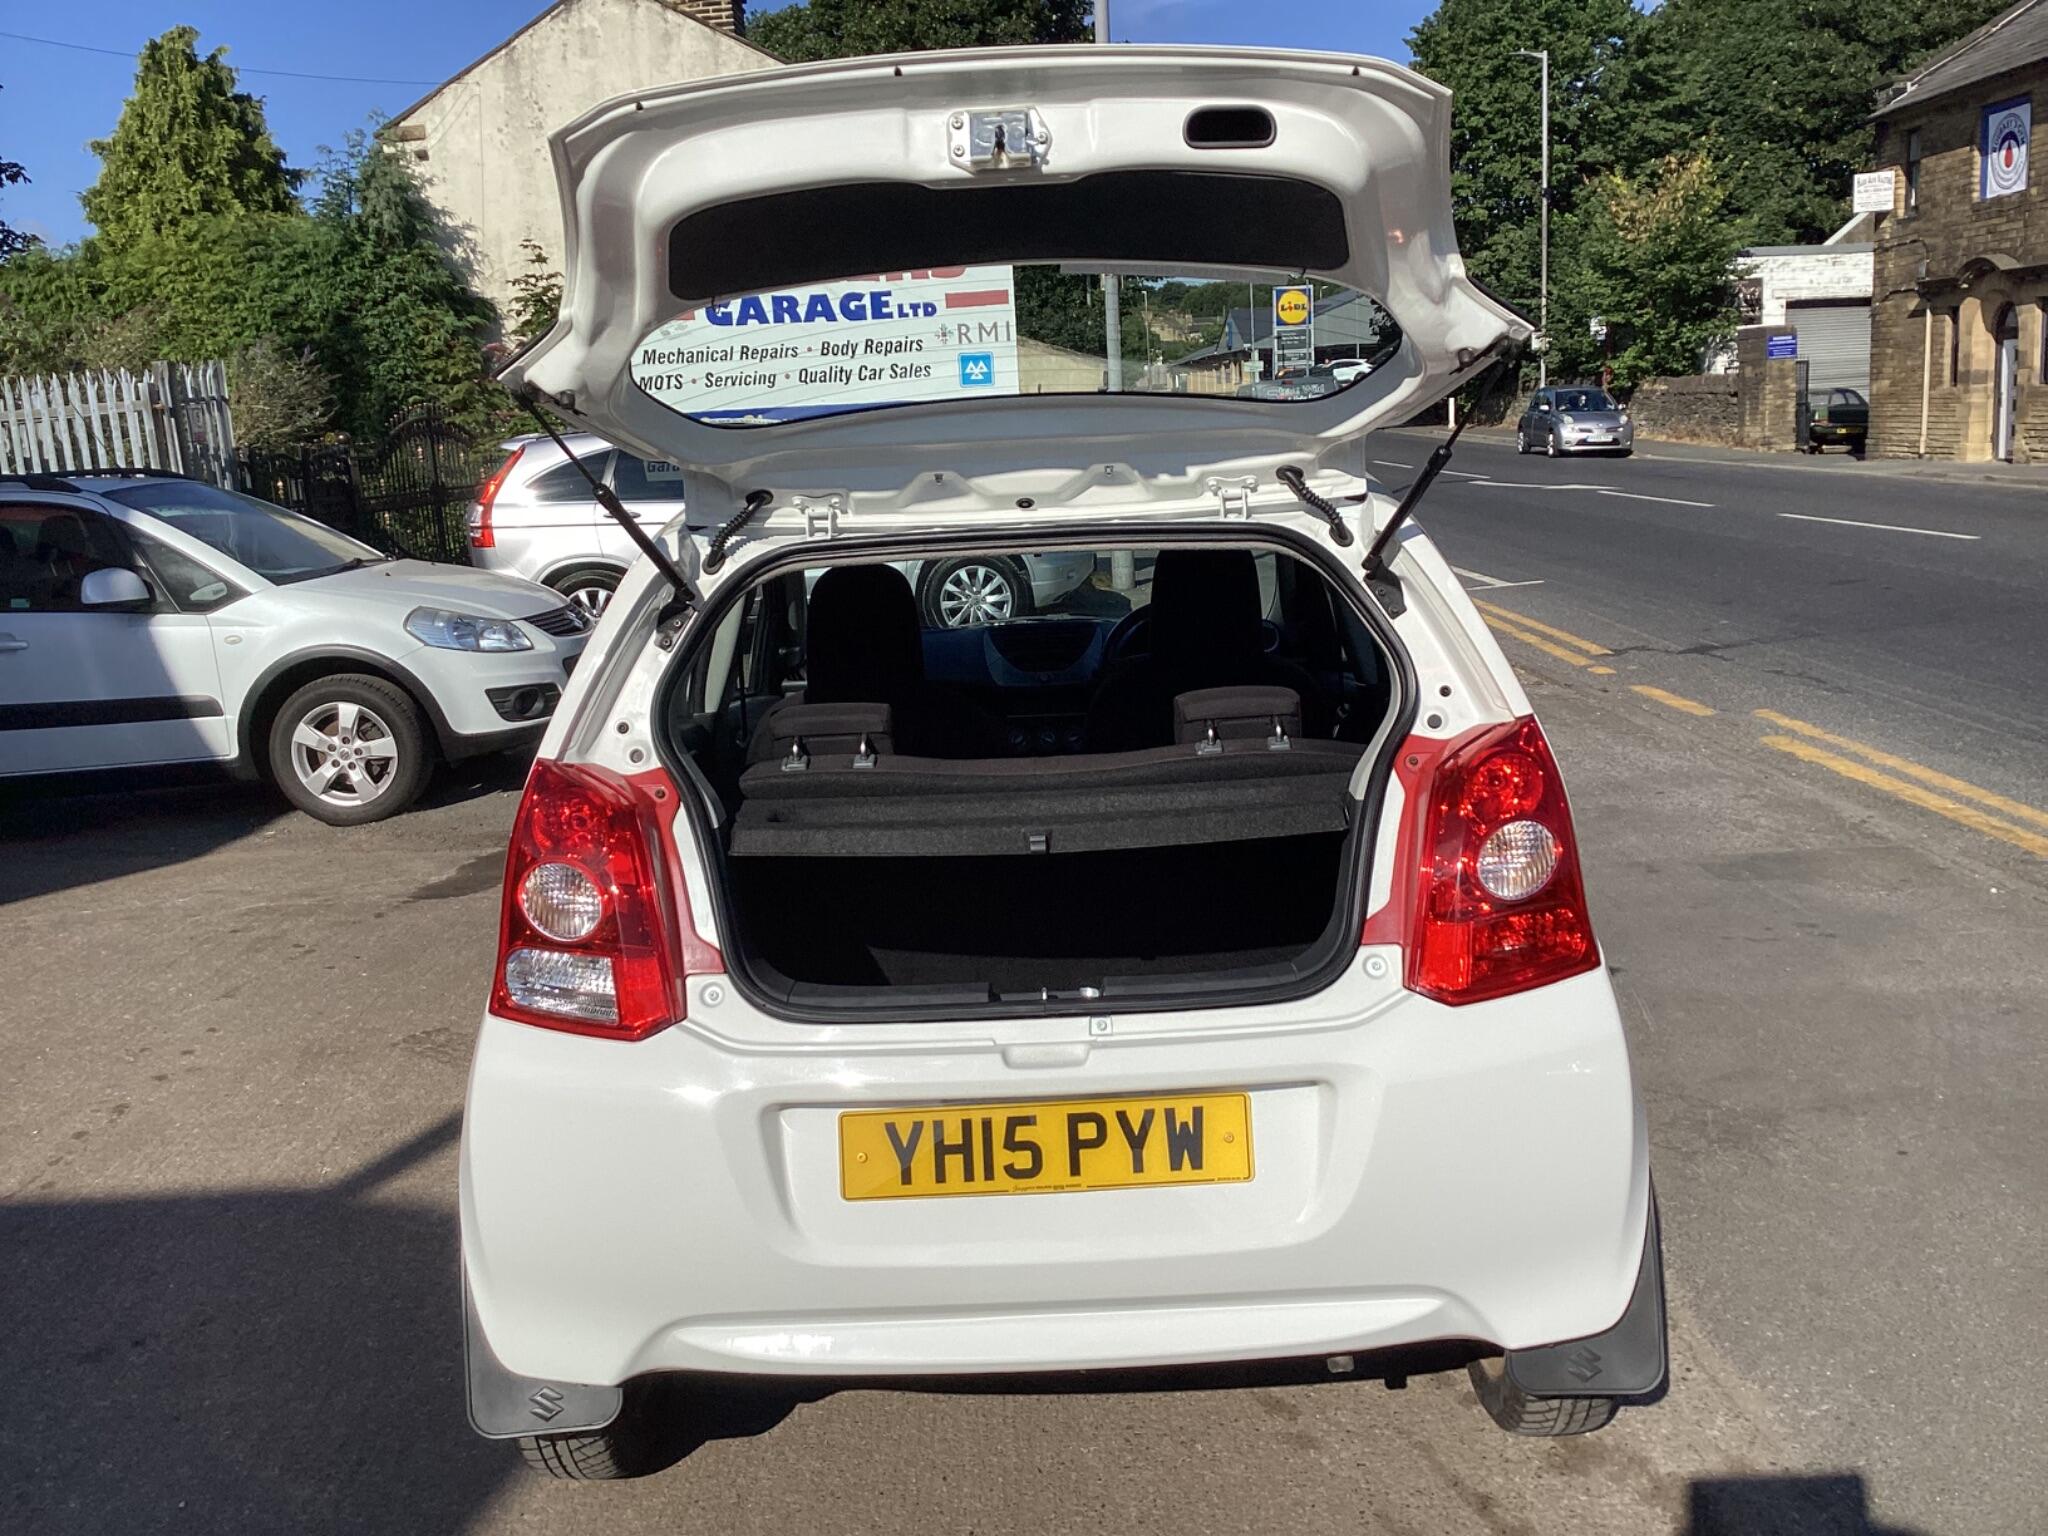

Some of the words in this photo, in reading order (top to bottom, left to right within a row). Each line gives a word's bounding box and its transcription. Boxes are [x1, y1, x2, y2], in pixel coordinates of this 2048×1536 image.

[704, 290, 894, 326] GARAGE
[897, 301, 937, 318] LTD
[957, 321, 1012, 345] RMI
[641, 346, 734, 365] Mechanical
[740, 343, 799, 364] Repairs
[820, 340, 858, 359] Body
[864, 336, 924, 356] Repairs
[639, 373, 684, 391] MOTS
[704, 370, 777, 390] Servicing
[798, 365, 853, 385] Quality
[858, 364, 884, 381] Car
[890, 361, 932, 380] Sales
[884, 1114, 1044, 1186] YH15
[1067, 1105, 1205, 1177] PYW
